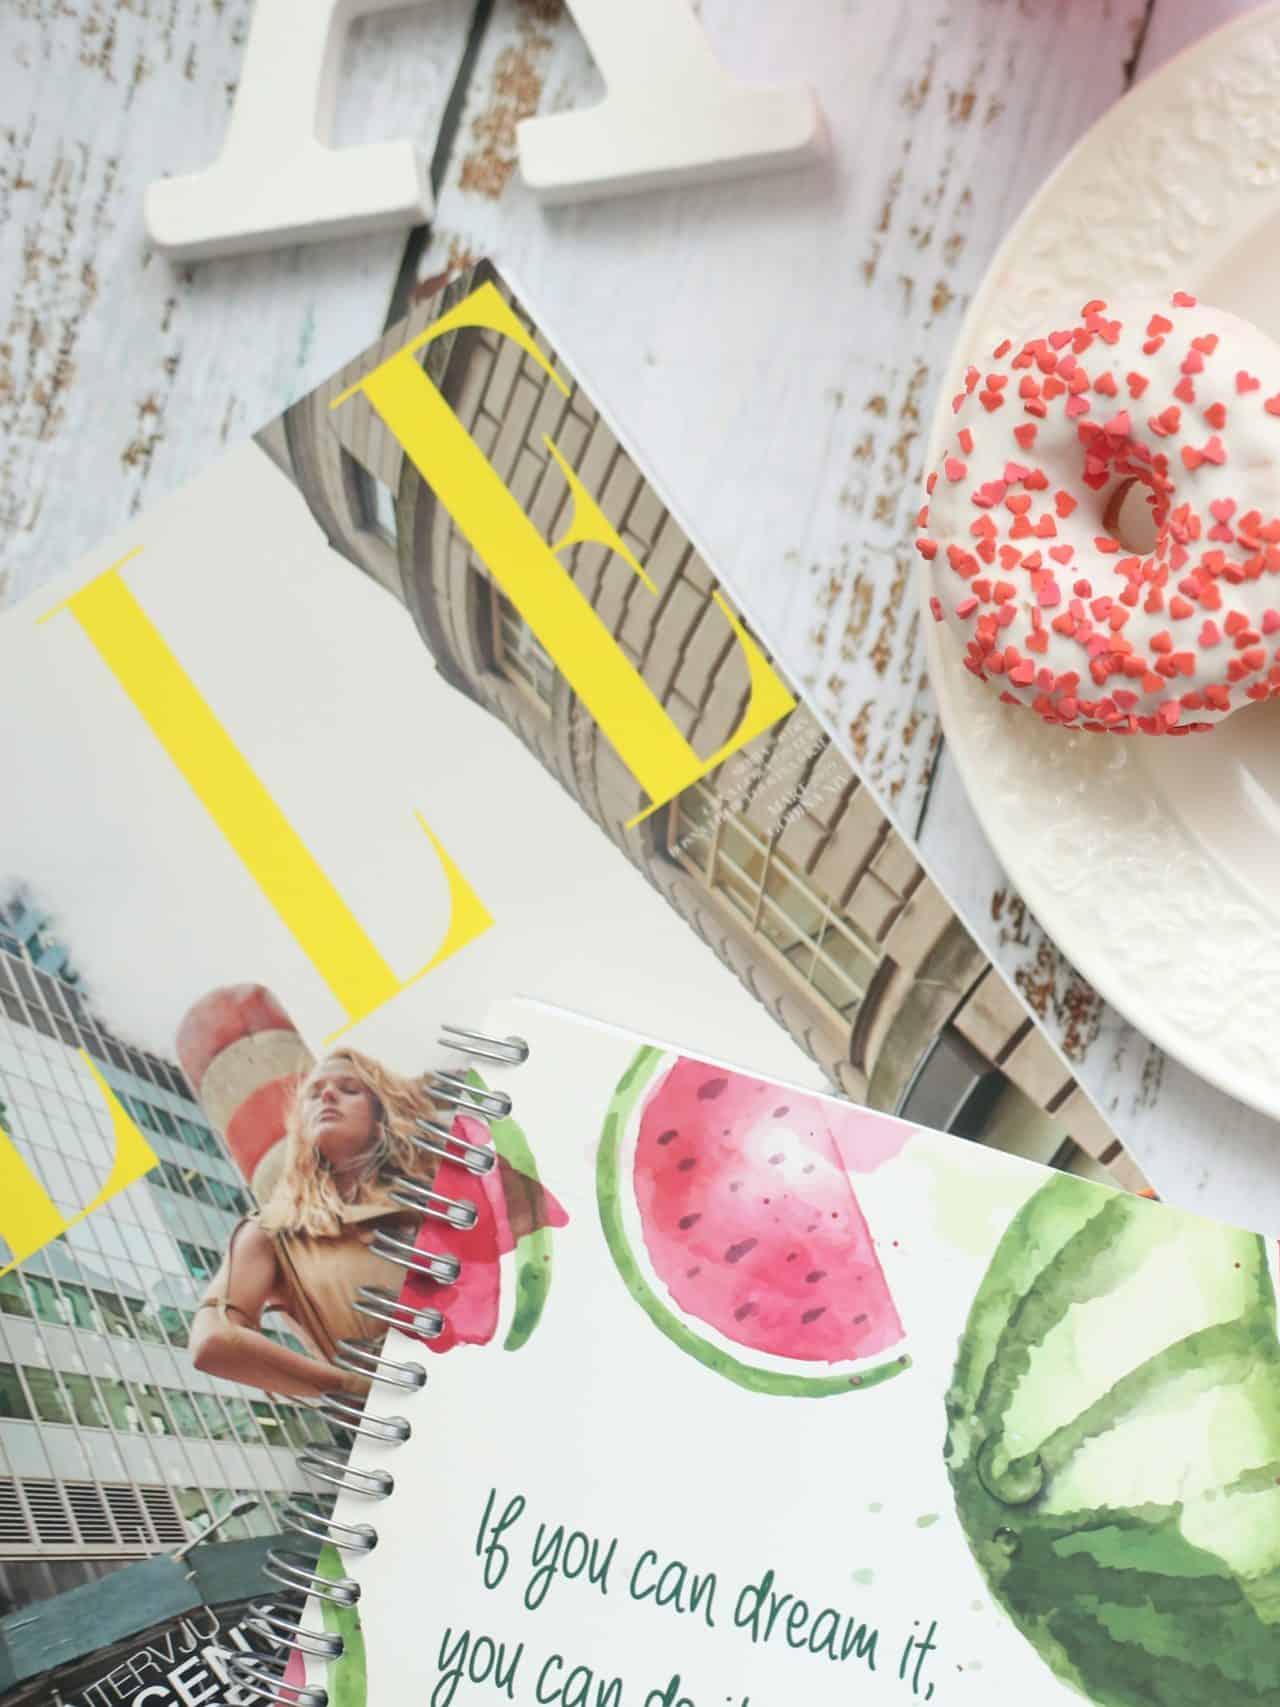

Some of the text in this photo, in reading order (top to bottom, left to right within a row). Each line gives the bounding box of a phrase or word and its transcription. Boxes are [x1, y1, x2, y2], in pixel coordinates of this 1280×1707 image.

[431, 1627, 525, 1707] you
[536, 1654, 622, 1707] can
[476, 1487, 938, 1701] If you can dream it,
